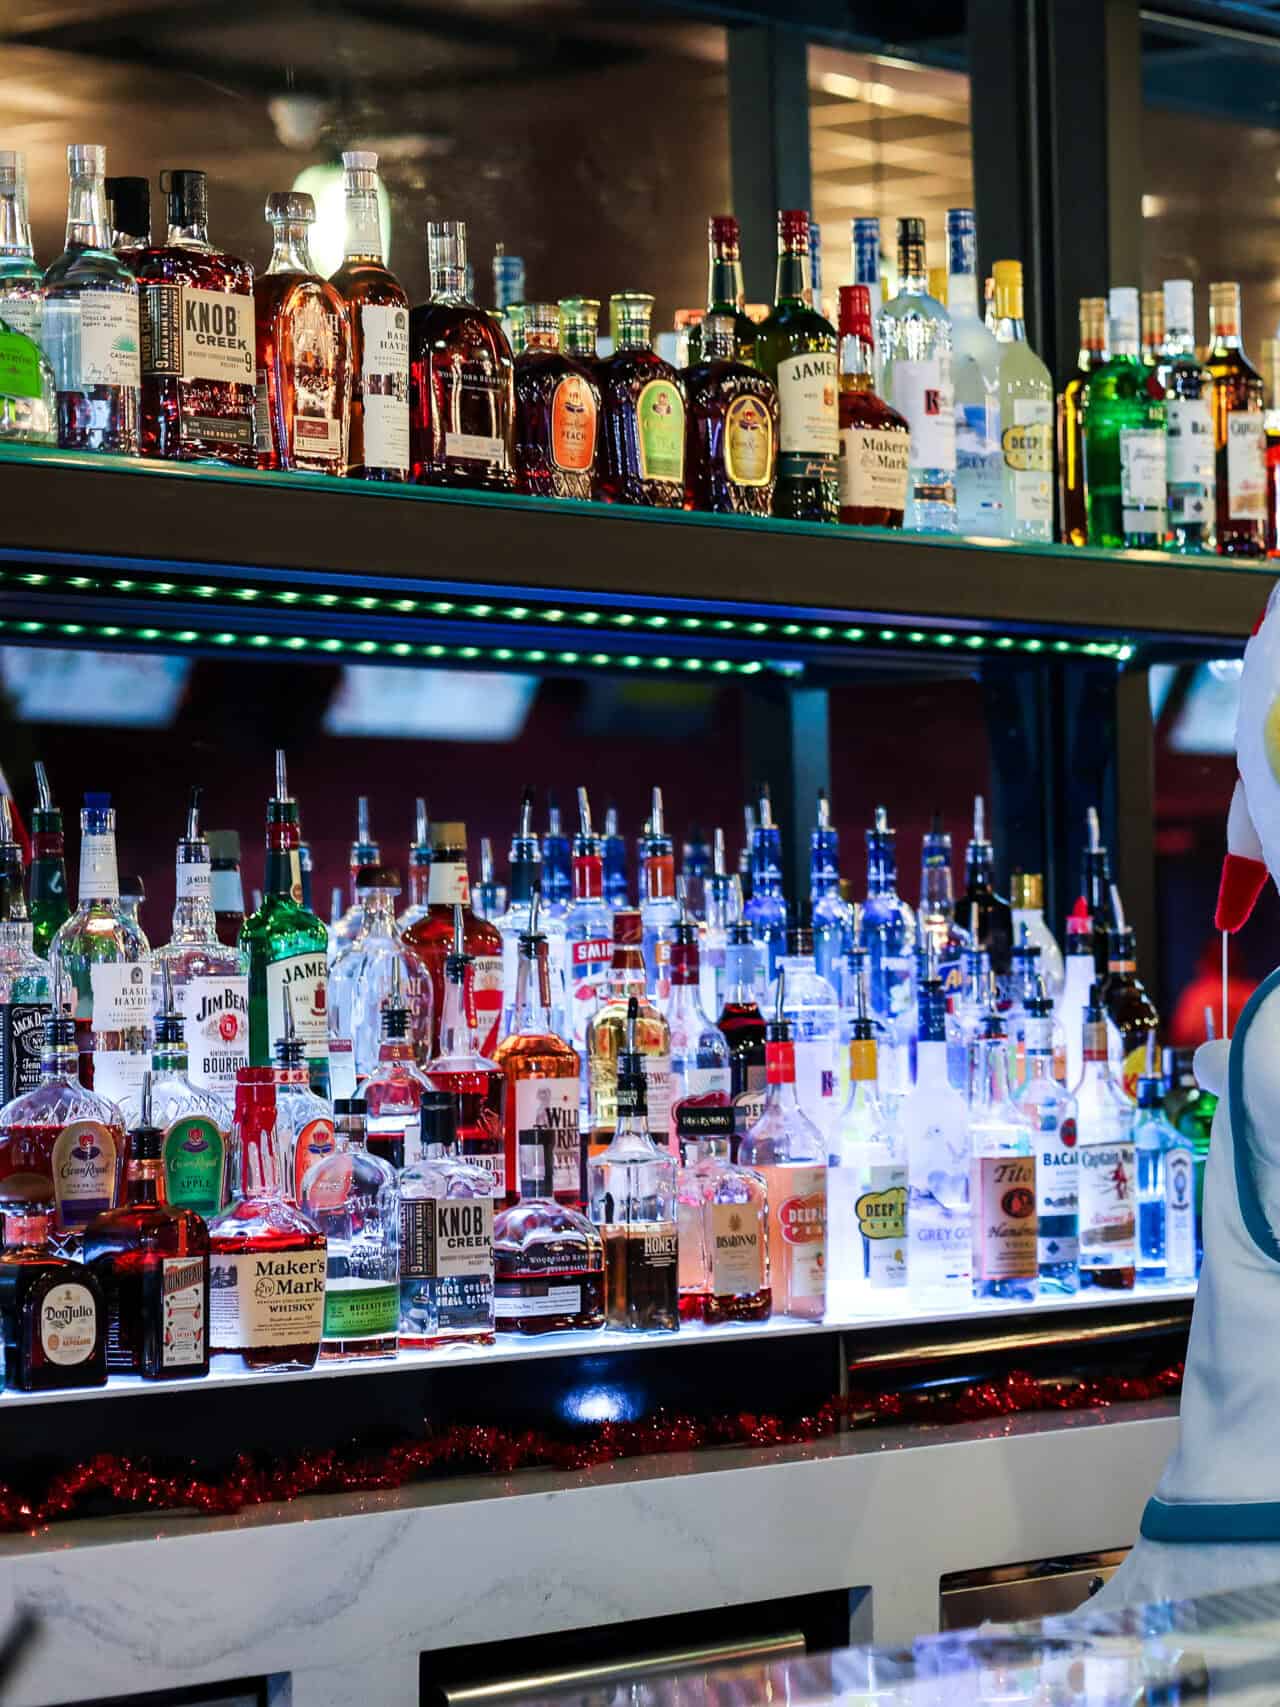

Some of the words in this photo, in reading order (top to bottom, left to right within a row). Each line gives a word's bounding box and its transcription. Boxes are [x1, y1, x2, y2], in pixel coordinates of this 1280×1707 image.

[185, 300, 237, 337] KNOB
[196, 333, 247, 350] CREEK
[244, 351, 253, 373] 9
[792, 360, 836, 381] JAME
[561, 431, 586, 441] PEACH
[196, 995, 223, 1022] JIM
[12, 1014, 34, 1037] JACK
[22, 1057, 41, 1071] Tenn
[465, 1157, 491, 1171] WILD
[993, 1163, 1034, 1184] Tito
[866, 1203, 894, 1217] DEEP
[438, 1207, 483, 1238] KNOB
[447, 1236, 491, 1249] CREEK
[918, 1228, 952, 1241] GREY
[645, 1237, 677, 1256] HONEY
[255, 1258, 326, 1277] Maker's
[276, 1277, 324, 1296] Mark
[269, 1302, 315, 1313] WHISKY
